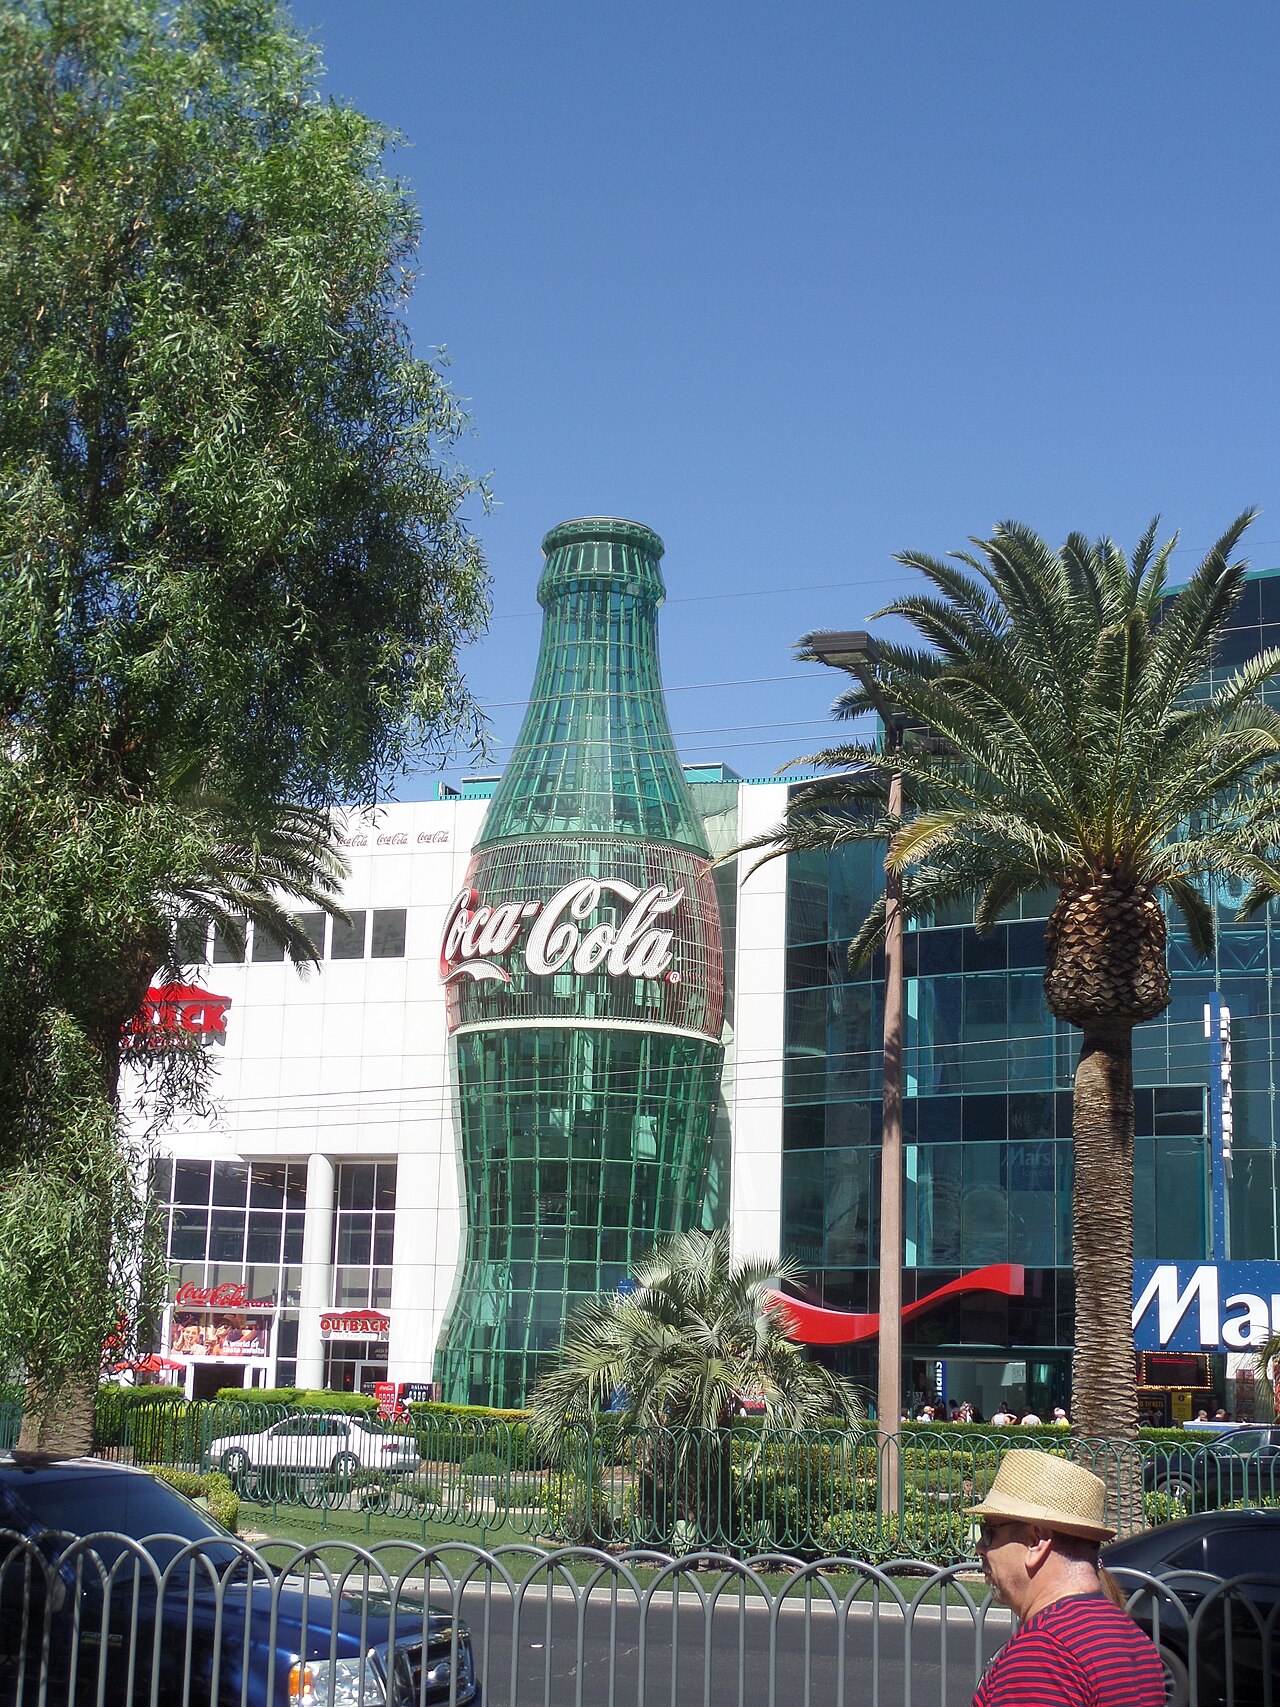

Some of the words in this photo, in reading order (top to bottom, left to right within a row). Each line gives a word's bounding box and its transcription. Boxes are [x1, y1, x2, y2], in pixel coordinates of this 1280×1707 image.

[437, 876, 684, 985] Coca-Cola
[320, 1319, 389, 1332] OUTBACK
[251, 1337, 259, 1348] of
